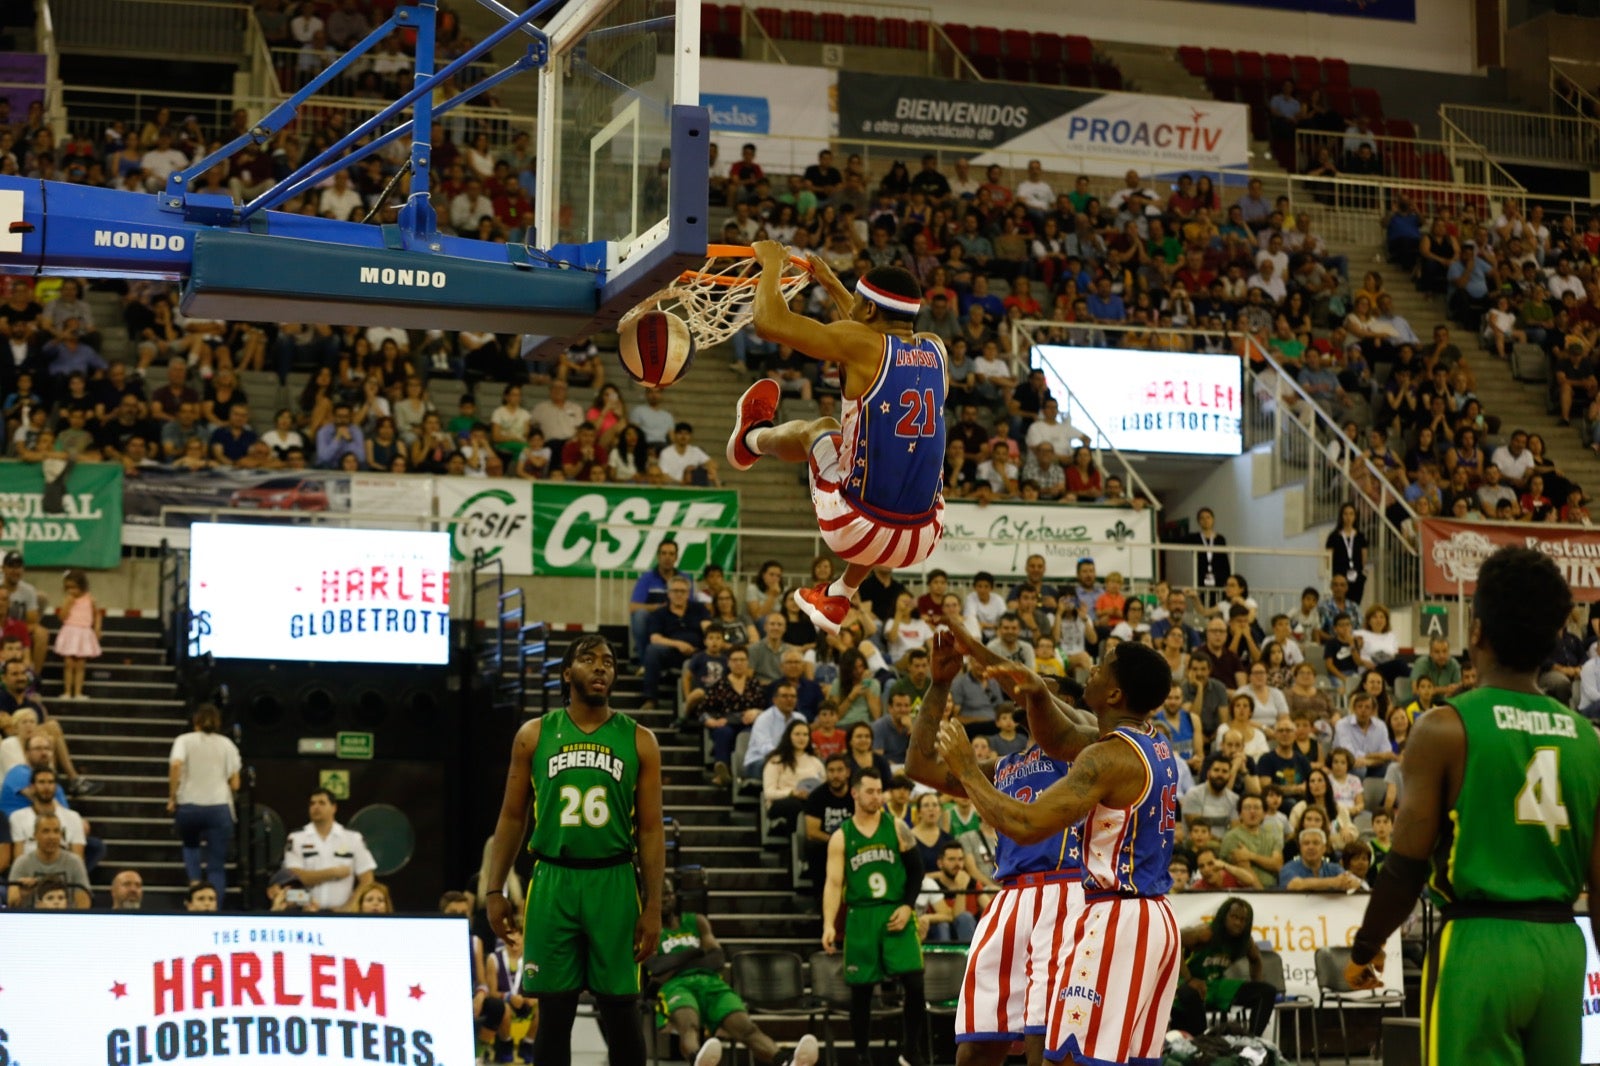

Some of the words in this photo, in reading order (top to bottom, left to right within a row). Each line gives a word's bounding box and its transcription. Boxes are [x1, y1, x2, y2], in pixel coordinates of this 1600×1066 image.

[896, 97, 1029, 128] BIENVENIDOS
[1068, 116, 1222, 151] PROACTIV
[94, 230, 185, 252] MONDO
[360, 267, 446, 288] MONDO
[894, 388, 937, 438] 21
[462, 512, 526, 538] CSIF
[544, 494, 726, 569] CSIF
[1525, 536, 1600, 557] Restau
[291, 608, 449, 639] GLOBETROTT
[1427, 614, 1443, 636] A
[1493, 705, 1578, 739] CHANDLER
[562, 743, 611, 754] WASHINGTON
[548, 751, 624, 782] GENERALS
[559, 785, 611, 828] 26
[1514, 746, 1571, 846] 4
[868, 872, 887, 898] 9
[213, 930, 240, 944] THE
[249, 929, 324, 946] ORIGINAL
[153, 951, 387, 1017] HARLEM
[1059, 985, 1102, 1007] HARLEM
